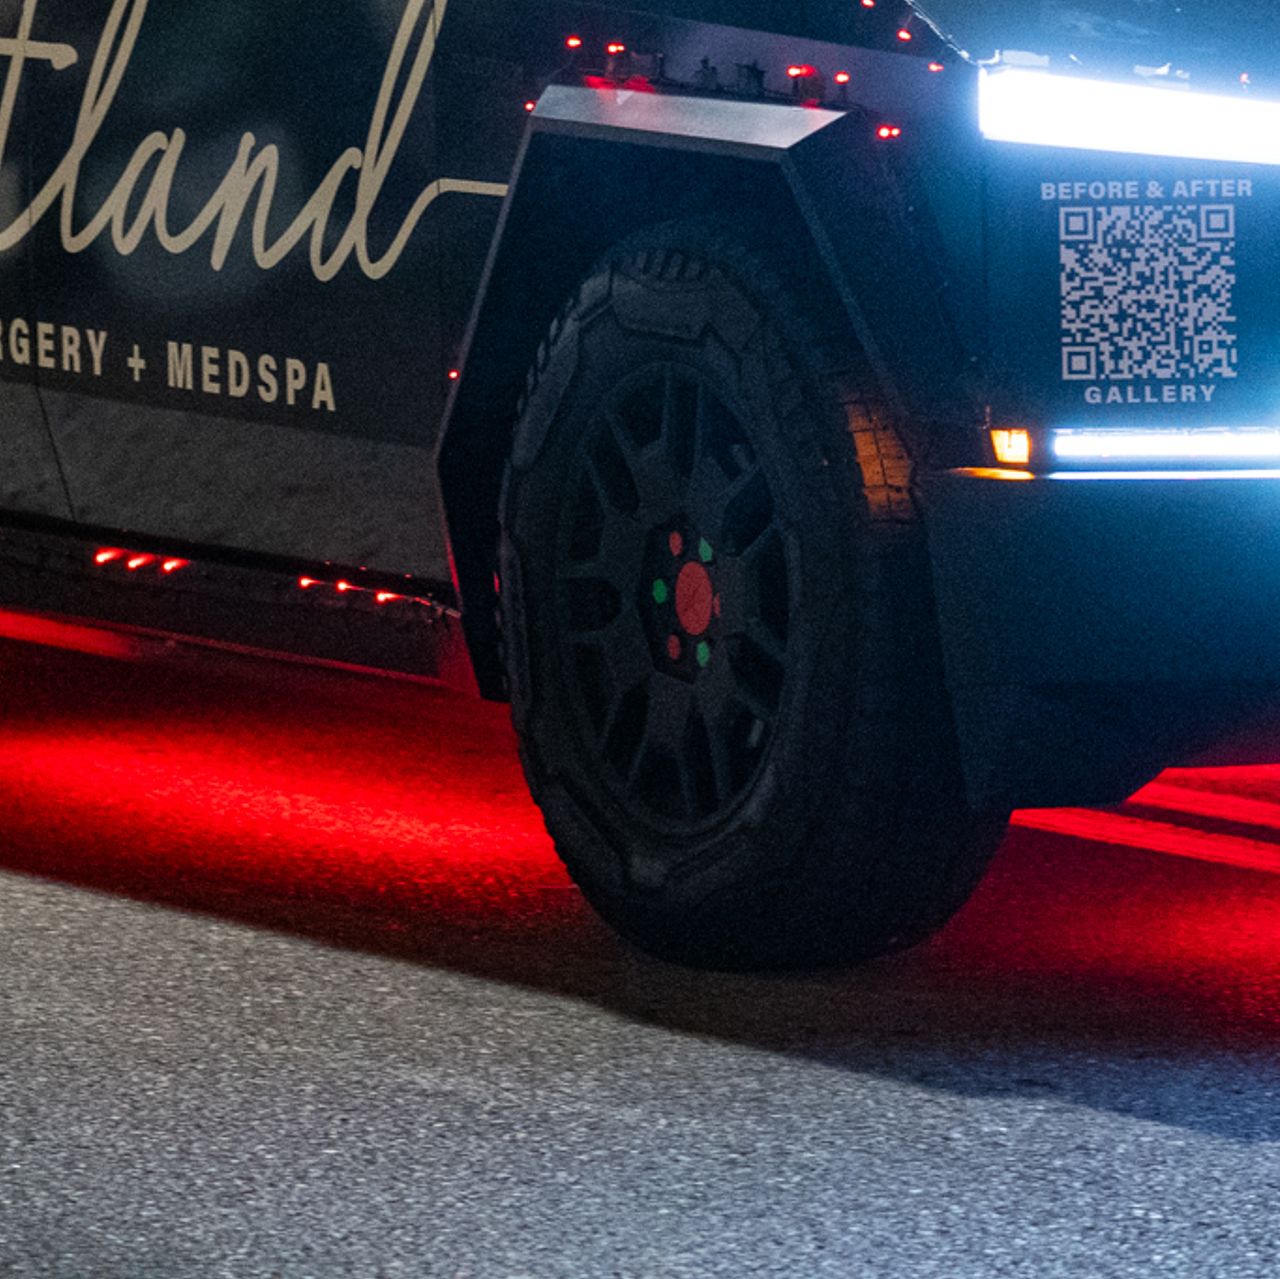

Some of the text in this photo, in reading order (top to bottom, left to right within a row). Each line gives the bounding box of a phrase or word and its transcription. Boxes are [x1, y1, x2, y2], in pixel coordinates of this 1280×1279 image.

[1040, 178, 1253, 201] BEFORE & AFTER
[166, 340, 337, 412] MEDSPA
[1084, 385, 1216, 404] GALLERY
